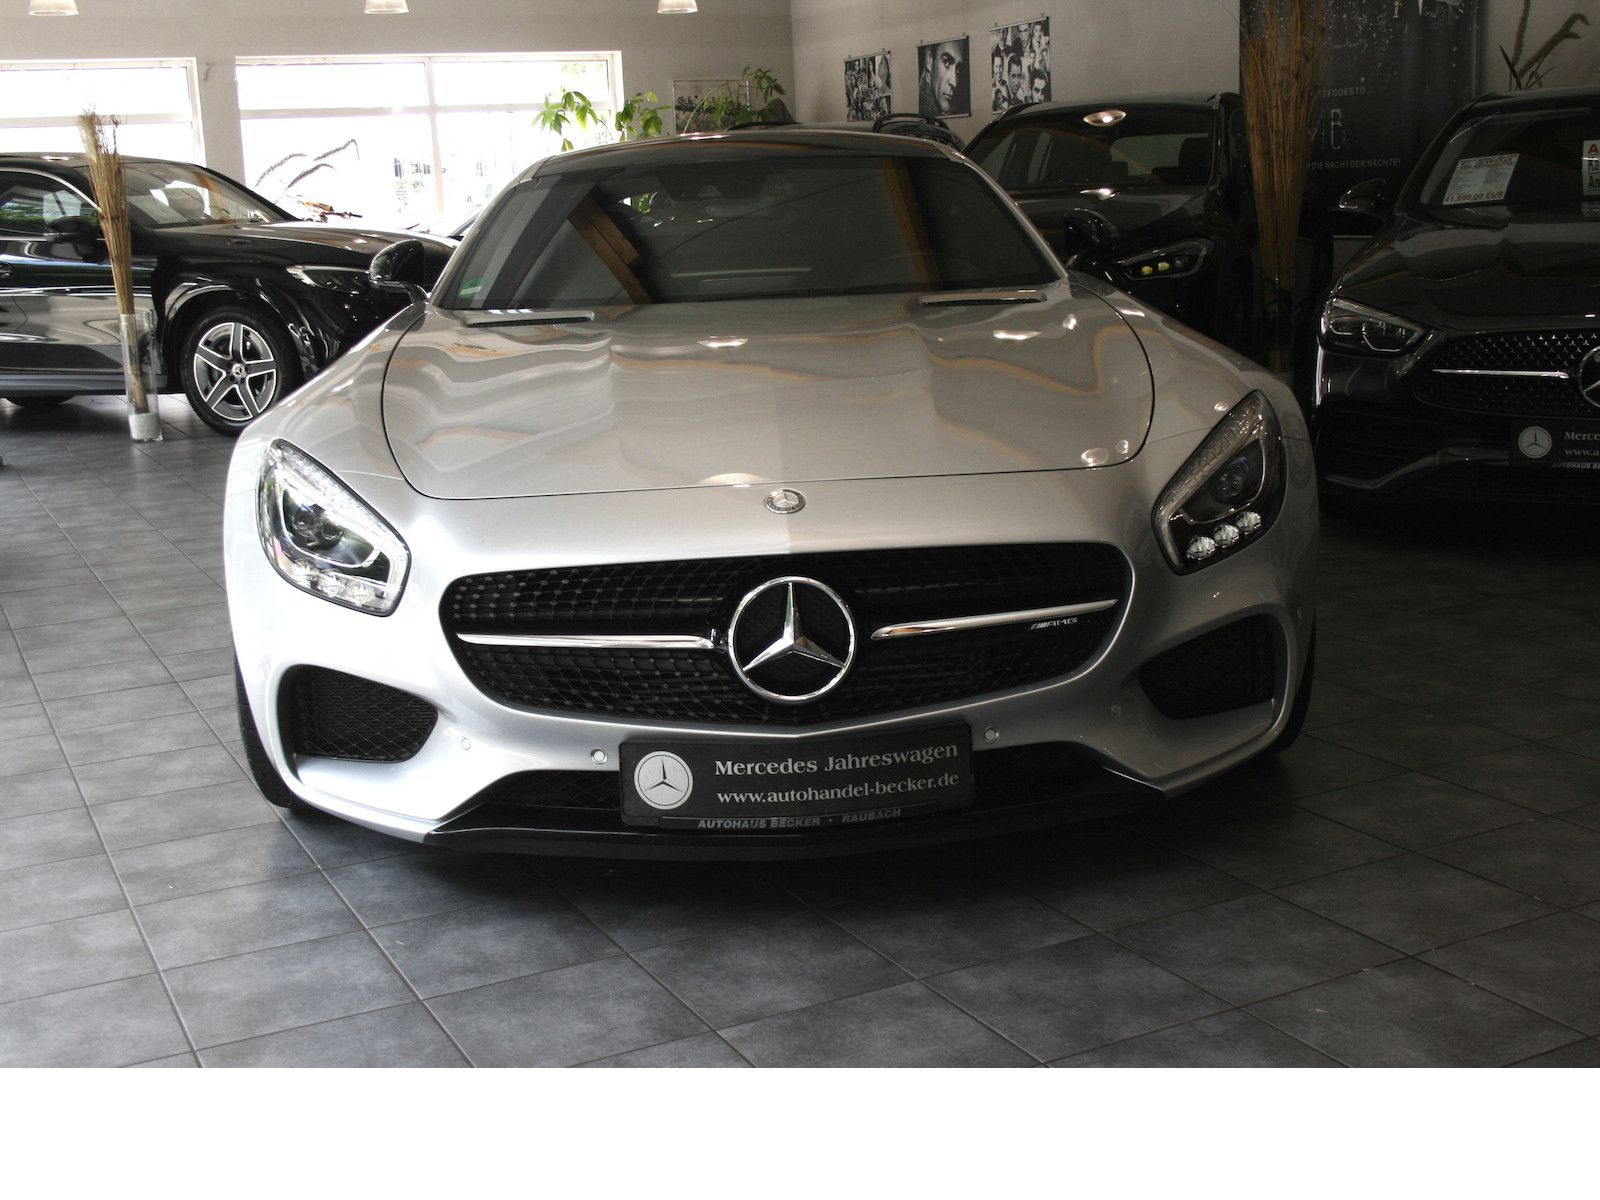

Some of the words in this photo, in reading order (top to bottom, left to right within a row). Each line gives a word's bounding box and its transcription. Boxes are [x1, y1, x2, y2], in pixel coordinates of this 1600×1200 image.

[1485, 190, 1504, 200] EUR
[714, 757, 819, 776] Mercedes
[824, 743, 959, 772] Jahreswagen
[717, 772, 961, 804] www.autohandel-becker.de
[697, 818, 767, 830] AUTOHAUS
[770, 816, 821, 829] BECKER
[842, 806, 902, 824] RAUBACH
